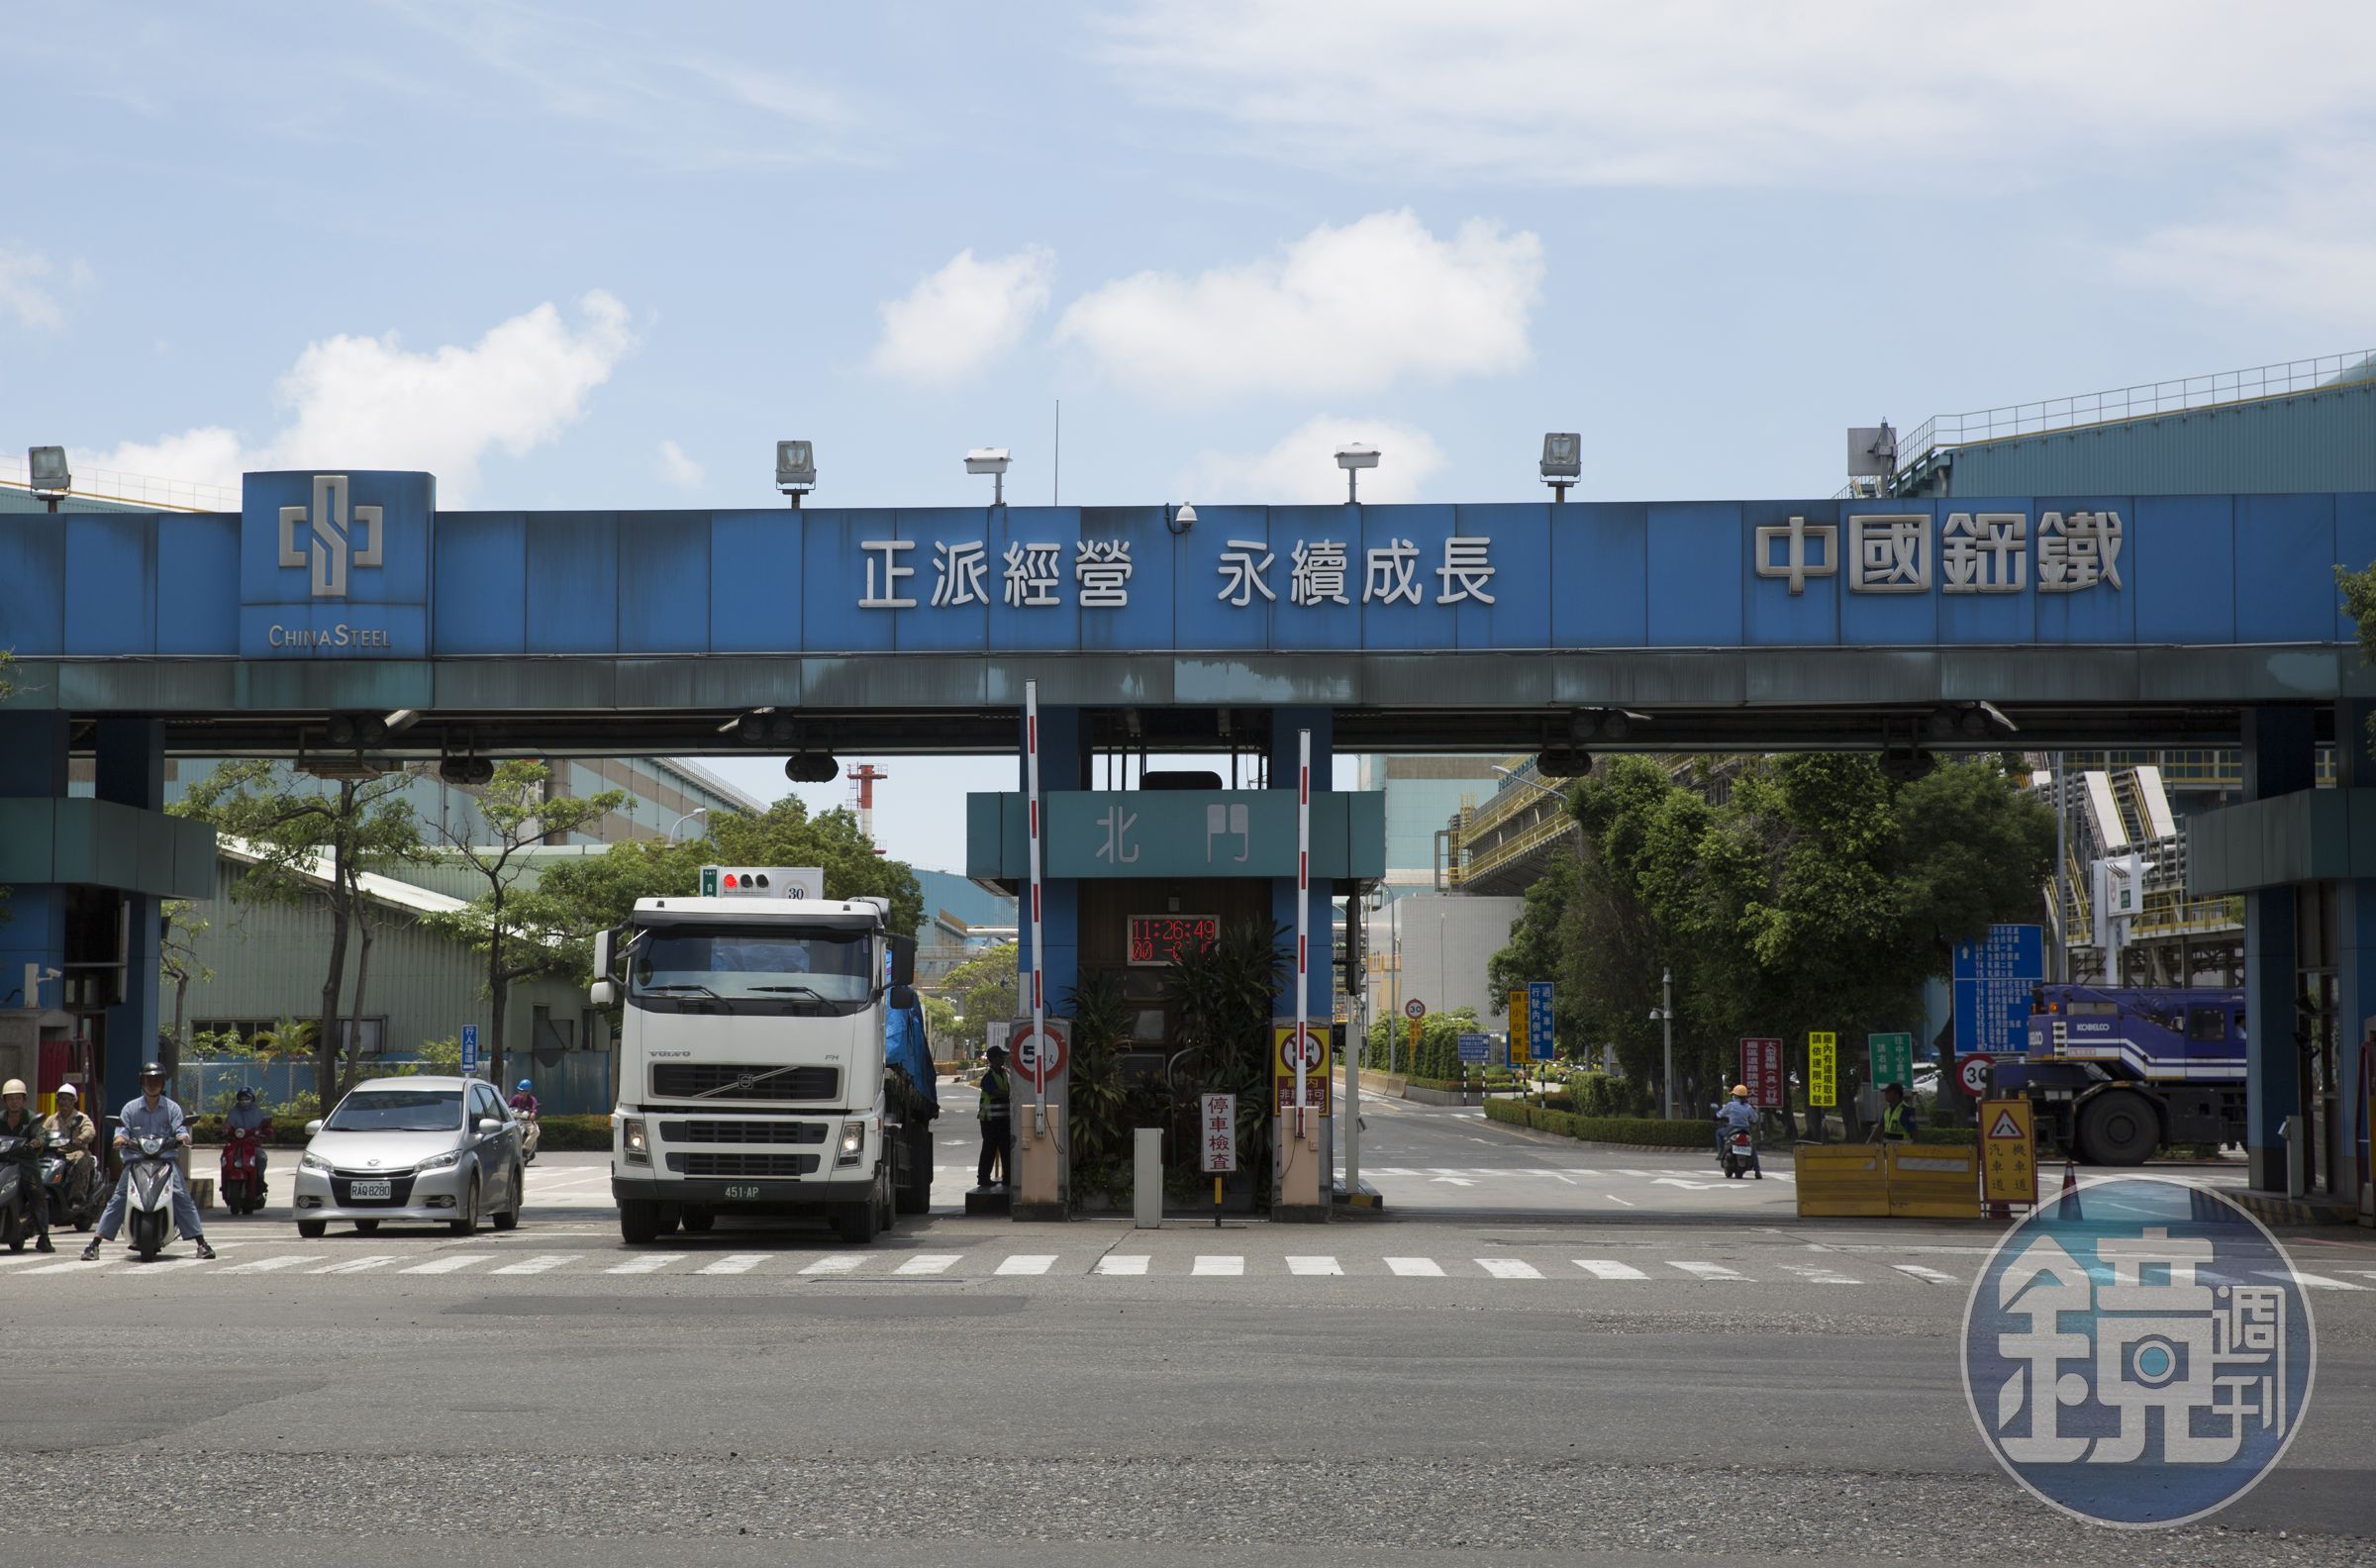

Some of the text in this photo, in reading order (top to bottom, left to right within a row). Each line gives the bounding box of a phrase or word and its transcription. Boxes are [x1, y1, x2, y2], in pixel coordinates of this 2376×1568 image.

[858, 538, 1495, 608] 正派經營 永續成長
[1755, 512, 2123, 594] 中國鋼鐵
[1096, 804, 1249, 864] 北門
[788, 888, 804, 900] 30
[1133, 920, 1215, 940] 11:26:49
[1208, 1097, 1231, 1170] 停車檢查
